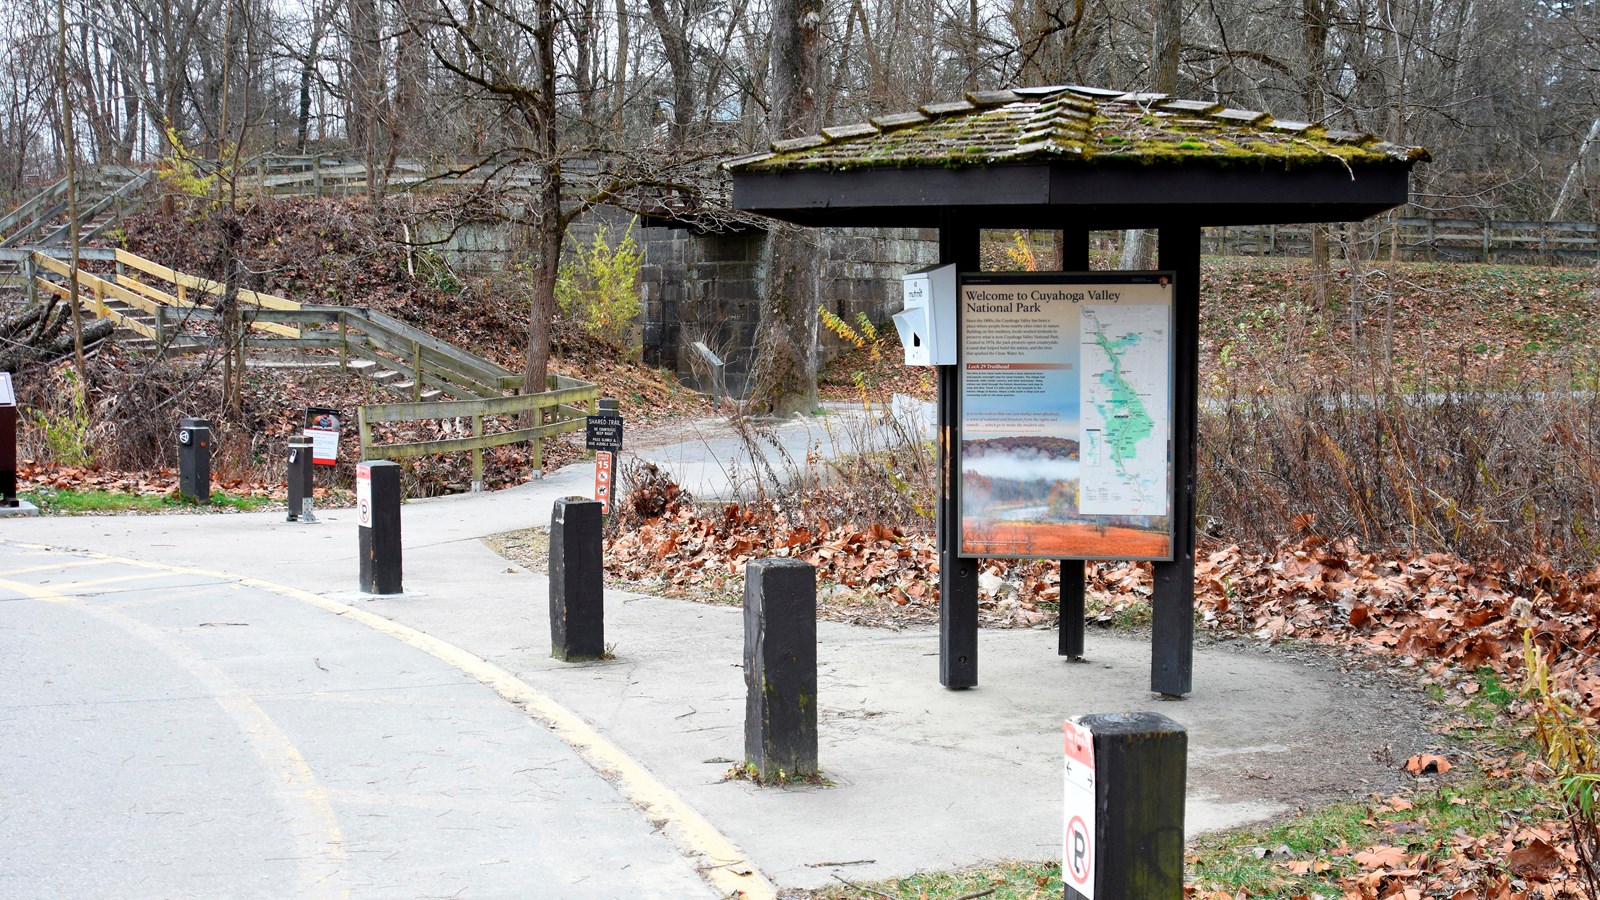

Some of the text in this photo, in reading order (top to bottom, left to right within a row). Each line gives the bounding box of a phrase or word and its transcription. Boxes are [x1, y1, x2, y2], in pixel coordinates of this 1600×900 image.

[966, 290, 1121, 303] Welcome to Cuyahoga Valley
[966, 303, 1041, 312] National Park
[598, 461, 609, 469] 15
